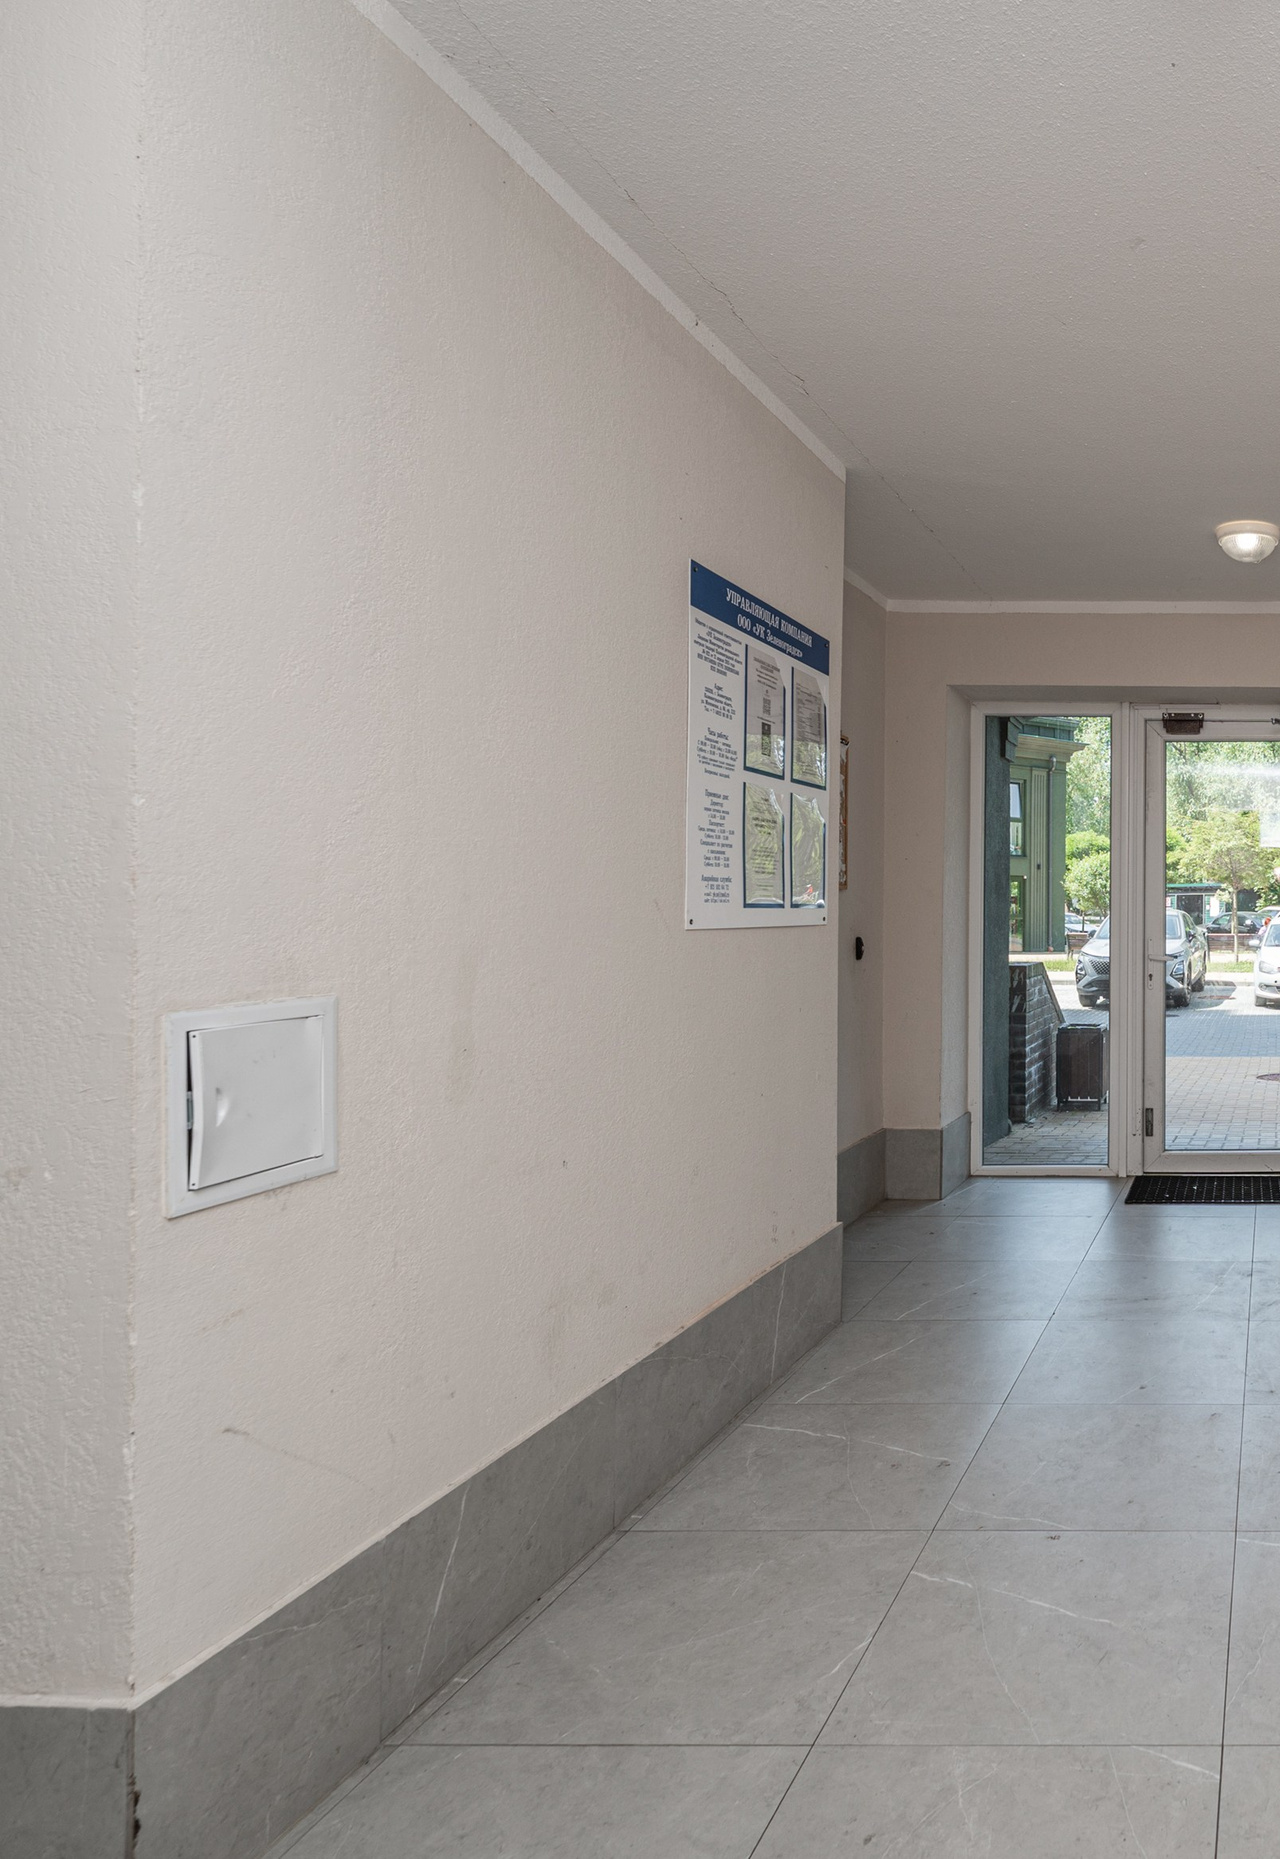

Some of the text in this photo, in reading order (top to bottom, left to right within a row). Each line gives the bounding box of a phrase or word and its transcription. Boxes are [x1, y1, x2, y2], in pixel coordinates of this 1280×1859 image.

[726, 588, 780, 628] УПРАВЛЯЮЩАЯ
[781, 619, 813, 648] КОМПАНИЯ
[737, 613, 752, 632] ООО
